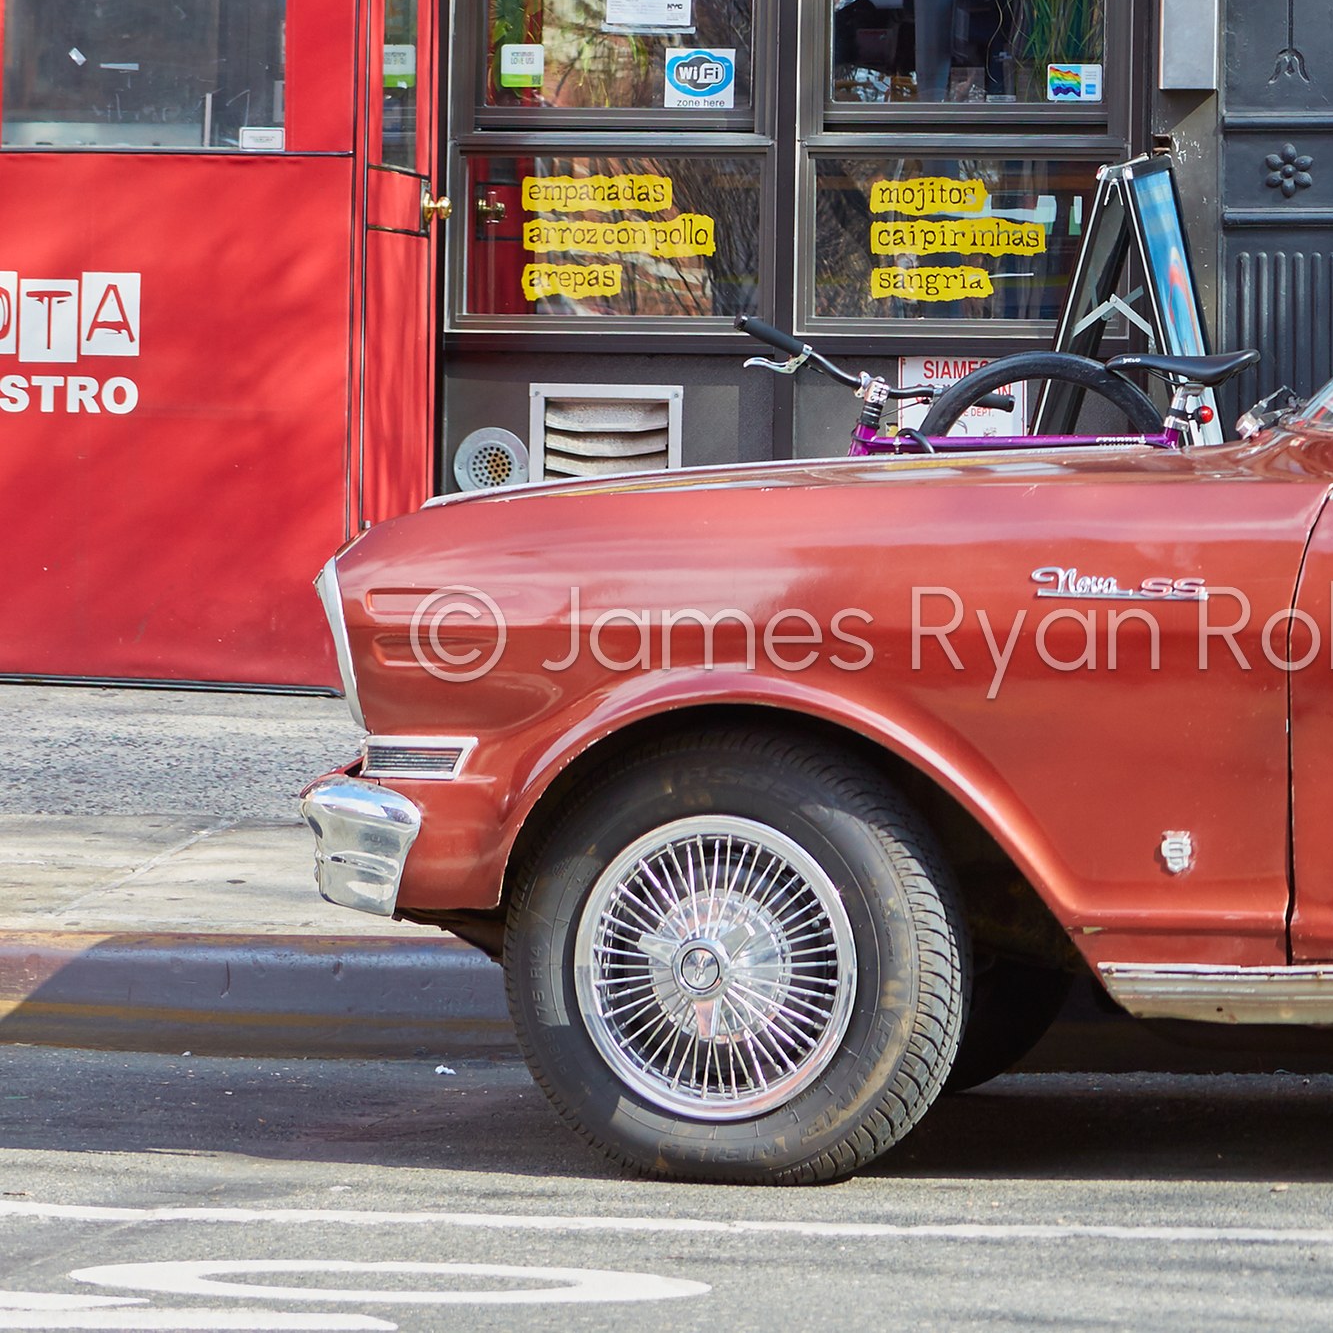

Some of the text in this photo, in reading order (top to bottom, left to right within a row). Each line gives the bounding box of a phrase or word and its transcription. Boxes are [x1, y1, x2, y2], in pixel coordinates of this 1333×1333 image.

[676, 97, 726, 108] zone here
[528, 180, 666, 209] empanadas
[877, 181, 977, 211] mojitos
[528, 217, 710, 252] arroz con pollo
[877, 222, 1042, 255] caipirinhas
[528, 267, 616, 295] arepas
[877, 267, 985, 297] sangria
[0, 283, 137, 351] TA
[970, 407, 995, 417] DEPT.
[1031, 566, 1206, 597] Nova SS
